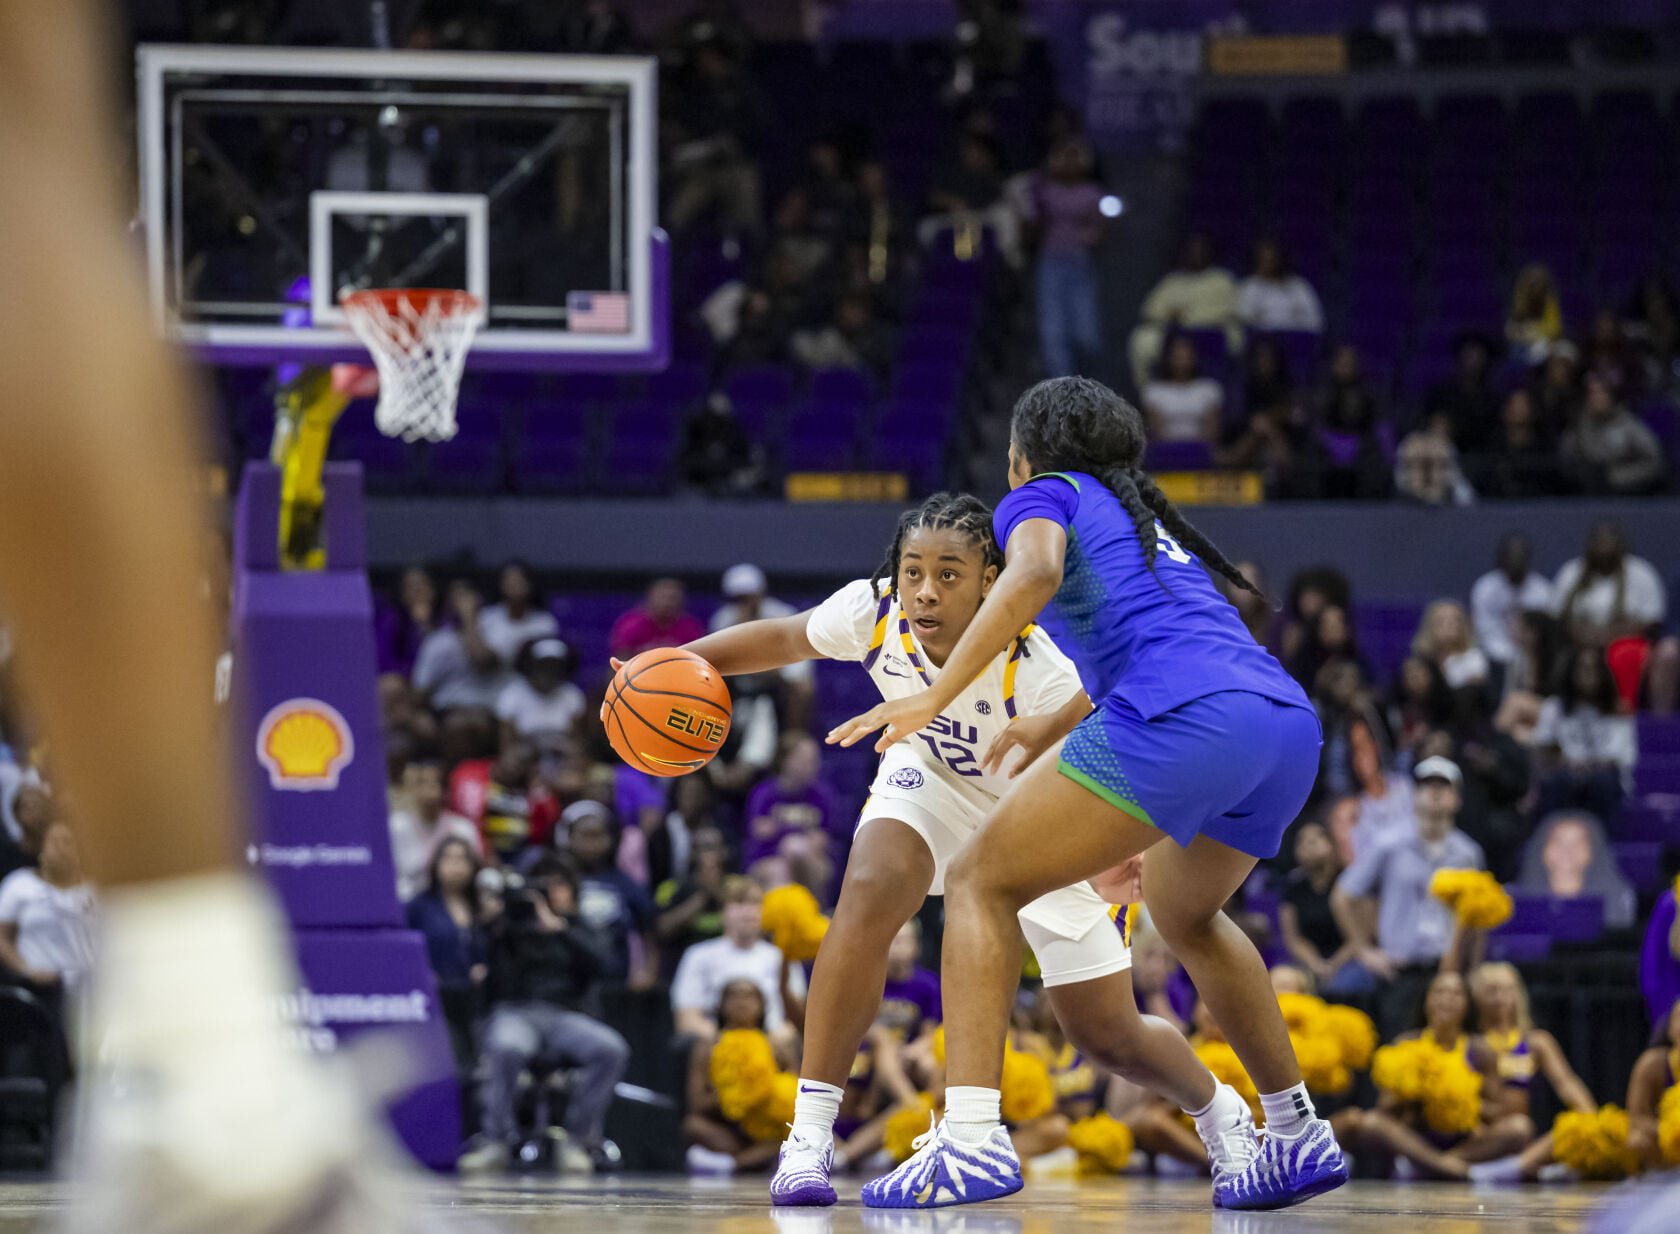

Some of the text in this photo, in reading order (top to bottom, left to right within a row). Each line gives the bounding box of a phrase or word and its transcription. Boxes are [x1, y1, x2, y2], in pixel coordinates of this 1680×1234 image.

[975, 700, 991, 715] SEC
[666, 708, 725, 744] ELITE
[926, 714, 978, 744] SU
[916, 732, 983, 776] 12
